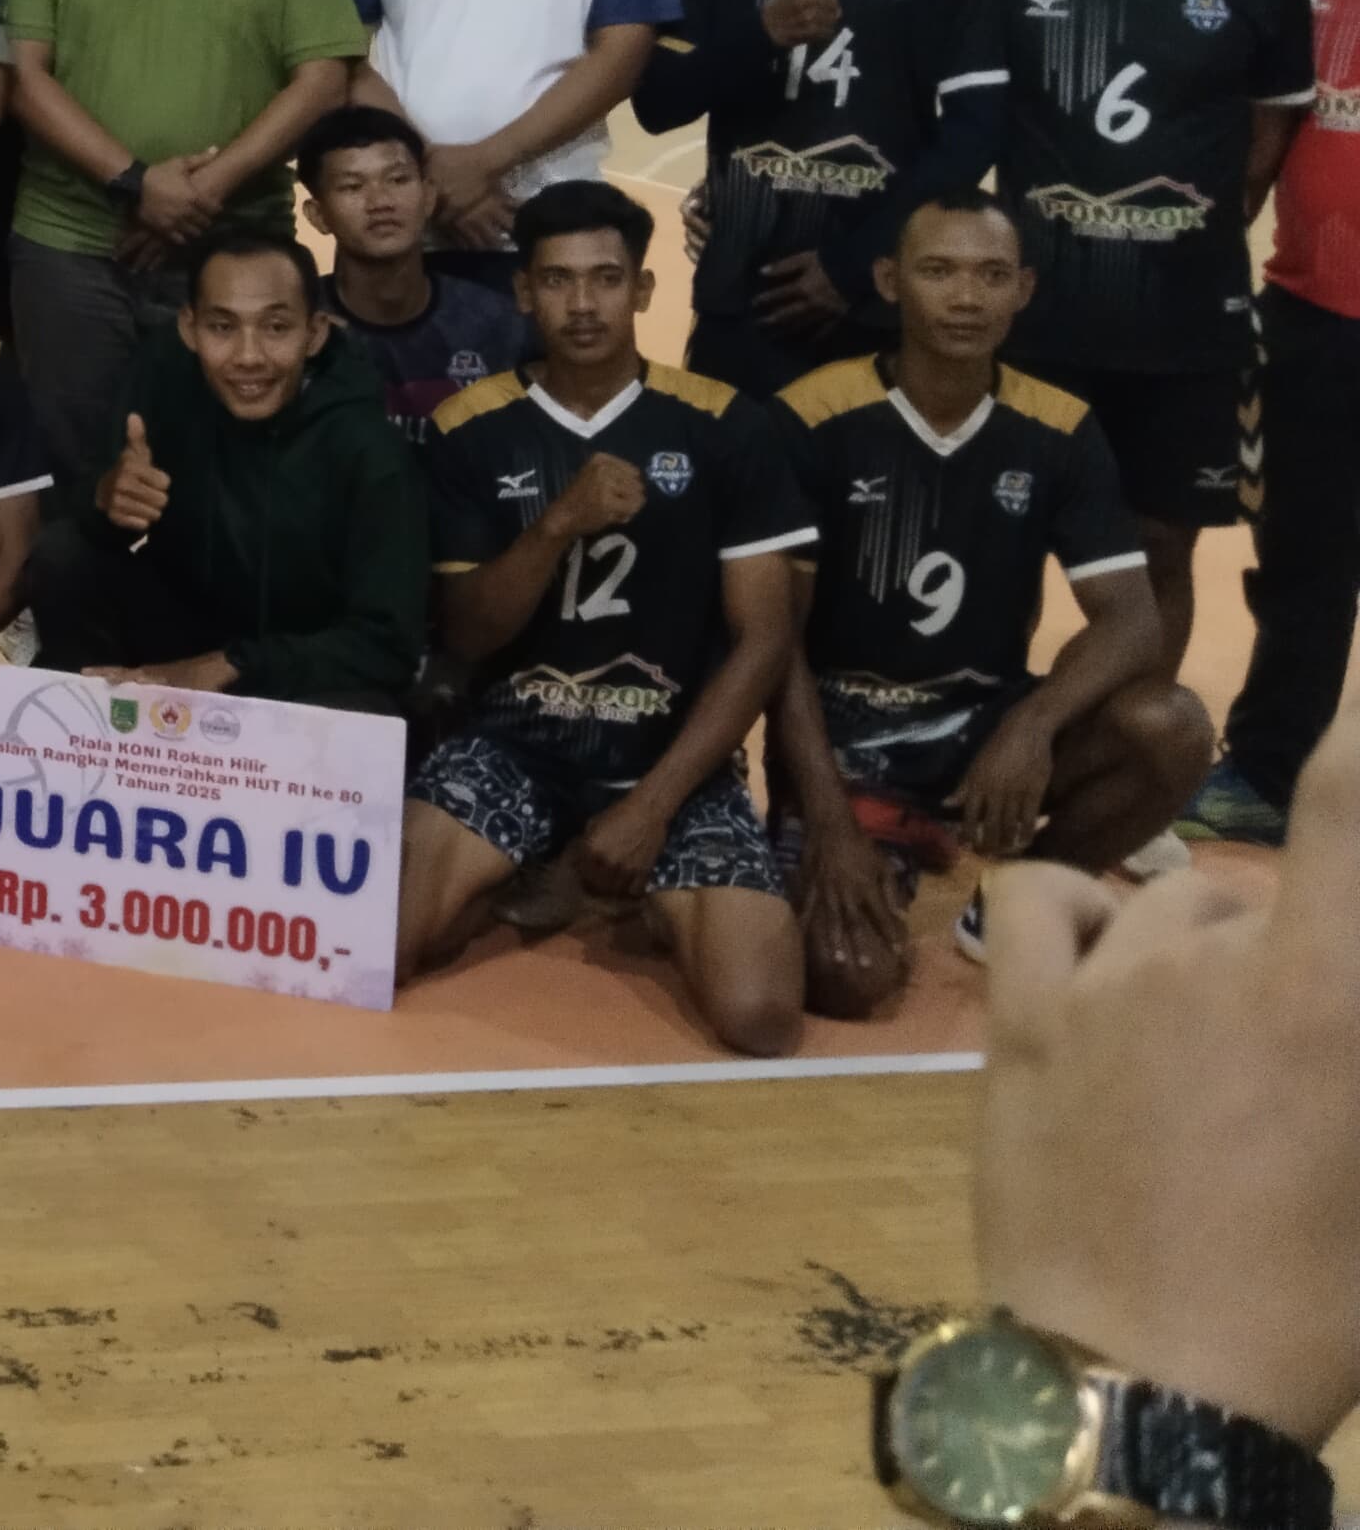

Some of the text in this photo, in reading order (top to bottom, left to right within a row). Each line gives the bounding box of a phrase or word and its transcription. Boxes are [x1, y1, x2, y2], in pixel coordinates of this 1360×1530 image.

[784, 27, 861, 107] 14
[1095, 62, 1151, 144] 6
[744, 154, 887, 190] PONDOK
[1040, 198, 1207, 229] PONDOK
[561, 532, 637, 621] 12
[908, 551, 965, 636] 9
[516, 680, 672, 714] PONDOK
[42, 746, 109, 769] Rangka
[114, 757, 240, 787] Memeriahkan
[245, 776, 281, 794] HUT
[287, 781, 306, 797] RI
[311, 786, 333, 802] ke
[339, 789, 363, 805] 80
[69, 734, 268, 774] Piala KONI Rokan Hilir
[116, 774, 222, 801] Tahun 2025
[79, 882, 351, 971] 3.000.000,-
